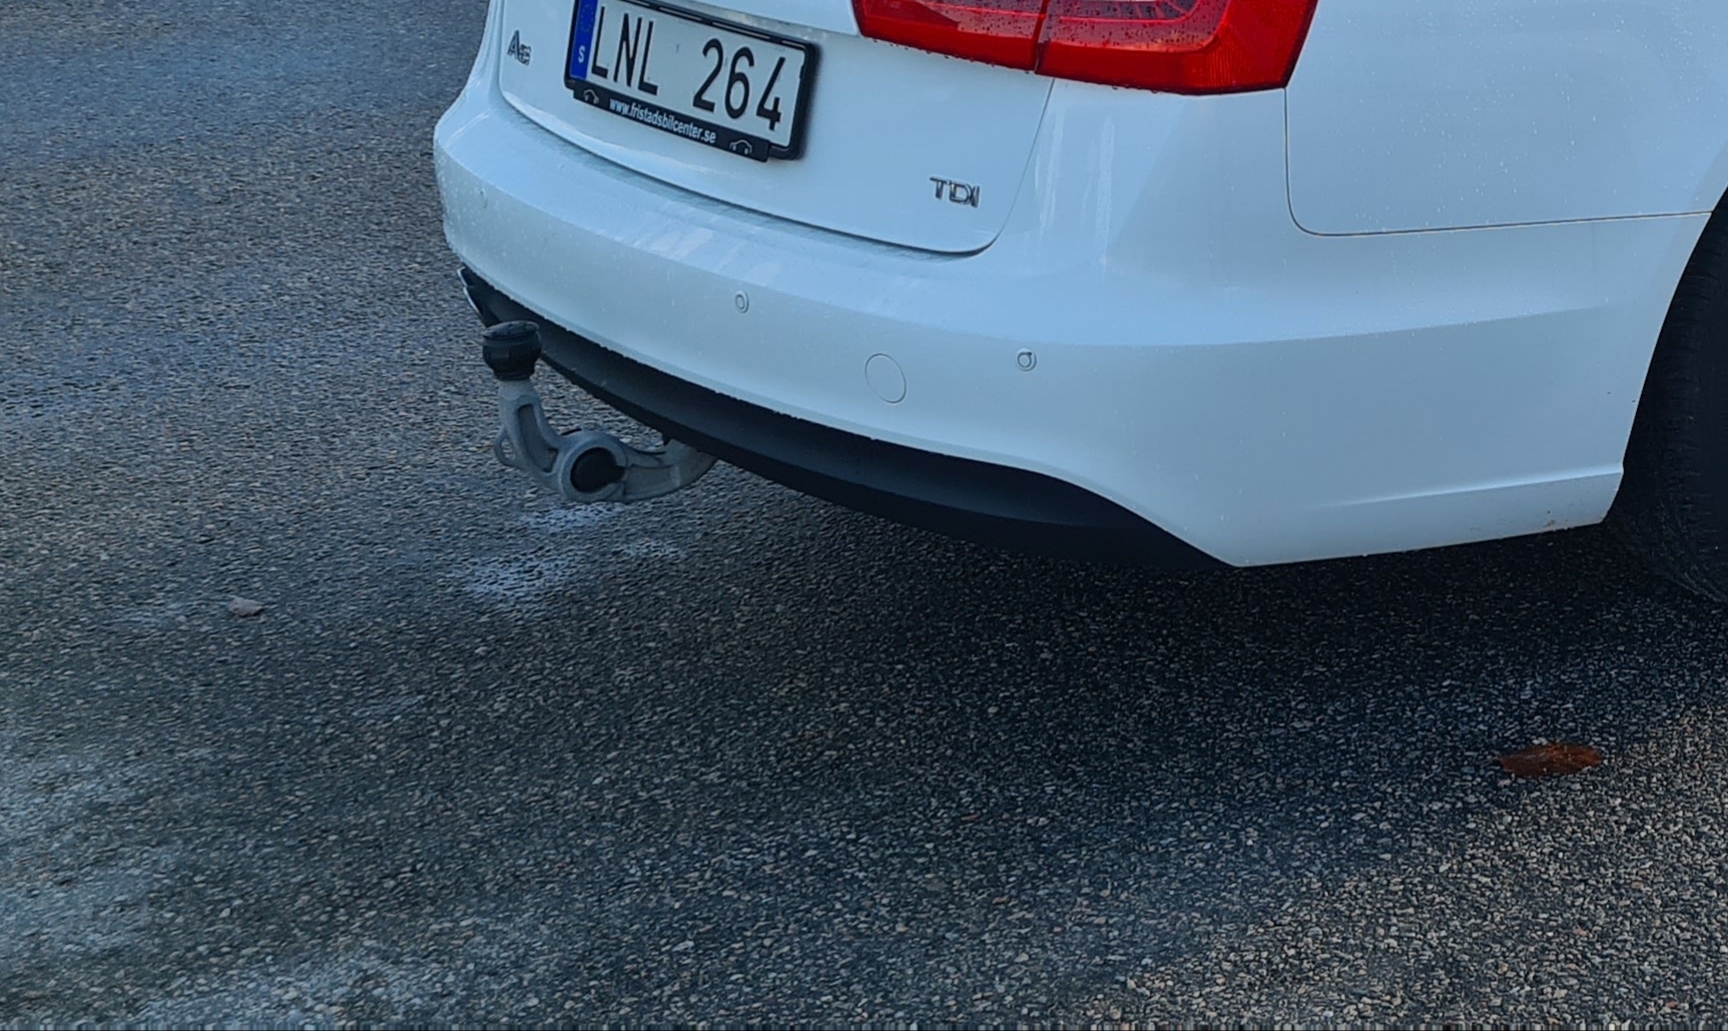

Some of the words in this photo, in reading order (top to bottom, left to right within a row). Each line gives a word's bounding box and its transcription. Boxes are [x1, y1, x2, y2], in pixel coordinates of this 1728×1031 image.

[590, 5, 660, 96] LNL
[692, 37, 786, 132] 264
[608, 96, 717, 144] www.fristadsbilcenter.se
[929, 176, 980, 209] TDI
